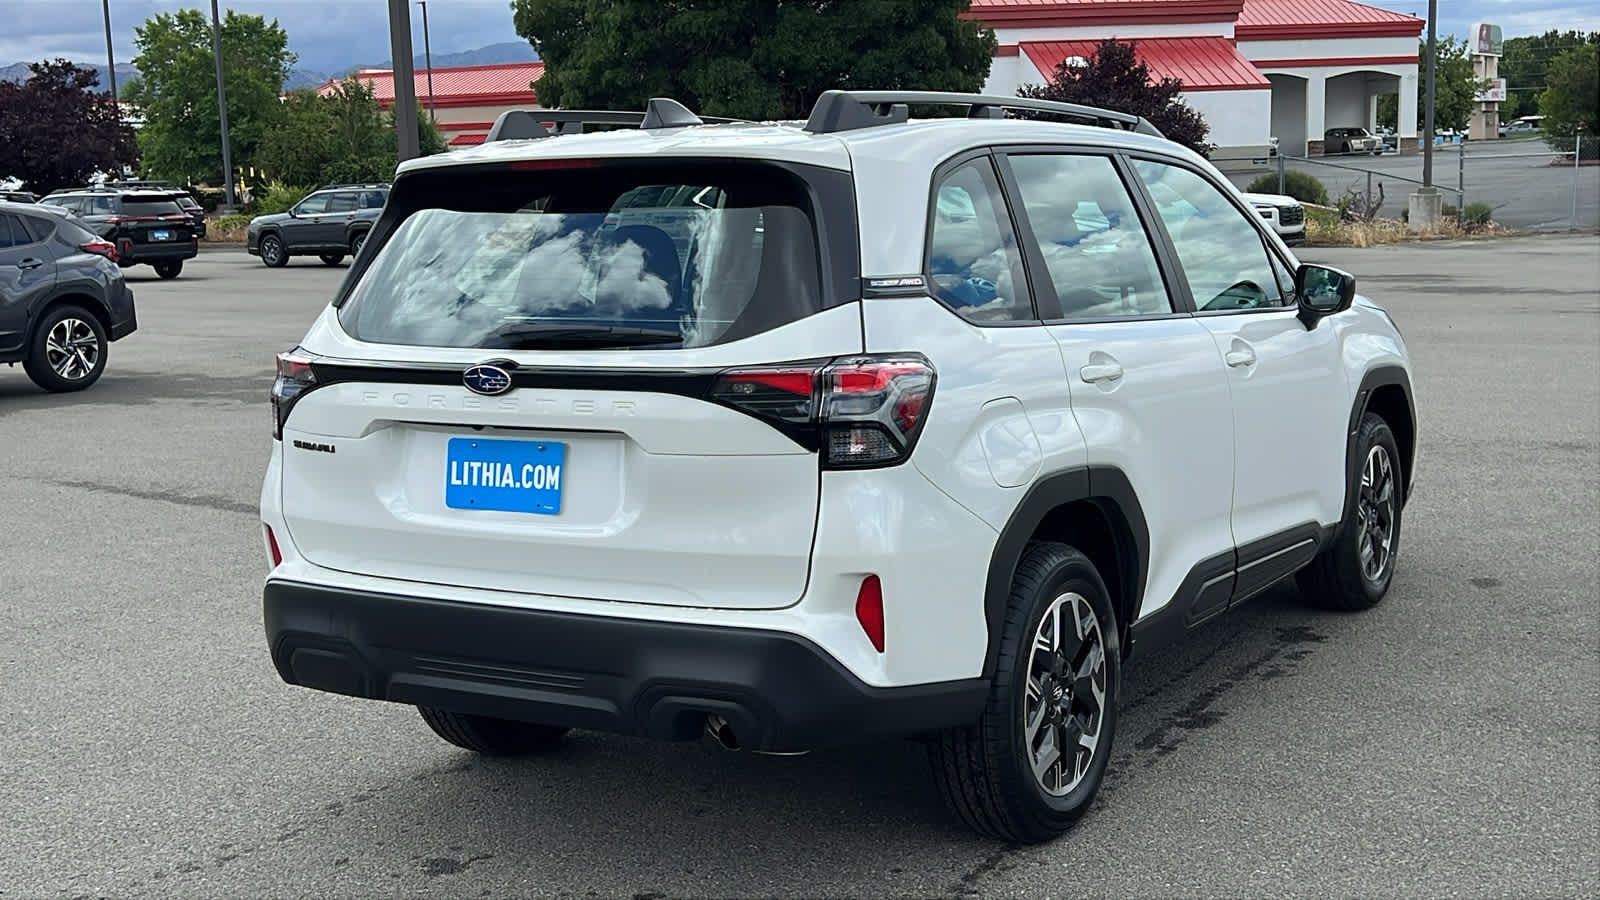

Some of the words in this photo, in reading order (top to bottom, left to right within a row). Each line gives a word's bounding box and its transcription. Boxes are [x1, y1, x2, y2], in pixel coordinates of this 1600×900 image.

[361, 391, 637, 417] FORESTER
[293, 440, 336, 453] SUBARU
[450, 461, 561, 490] LITHIA.COM
